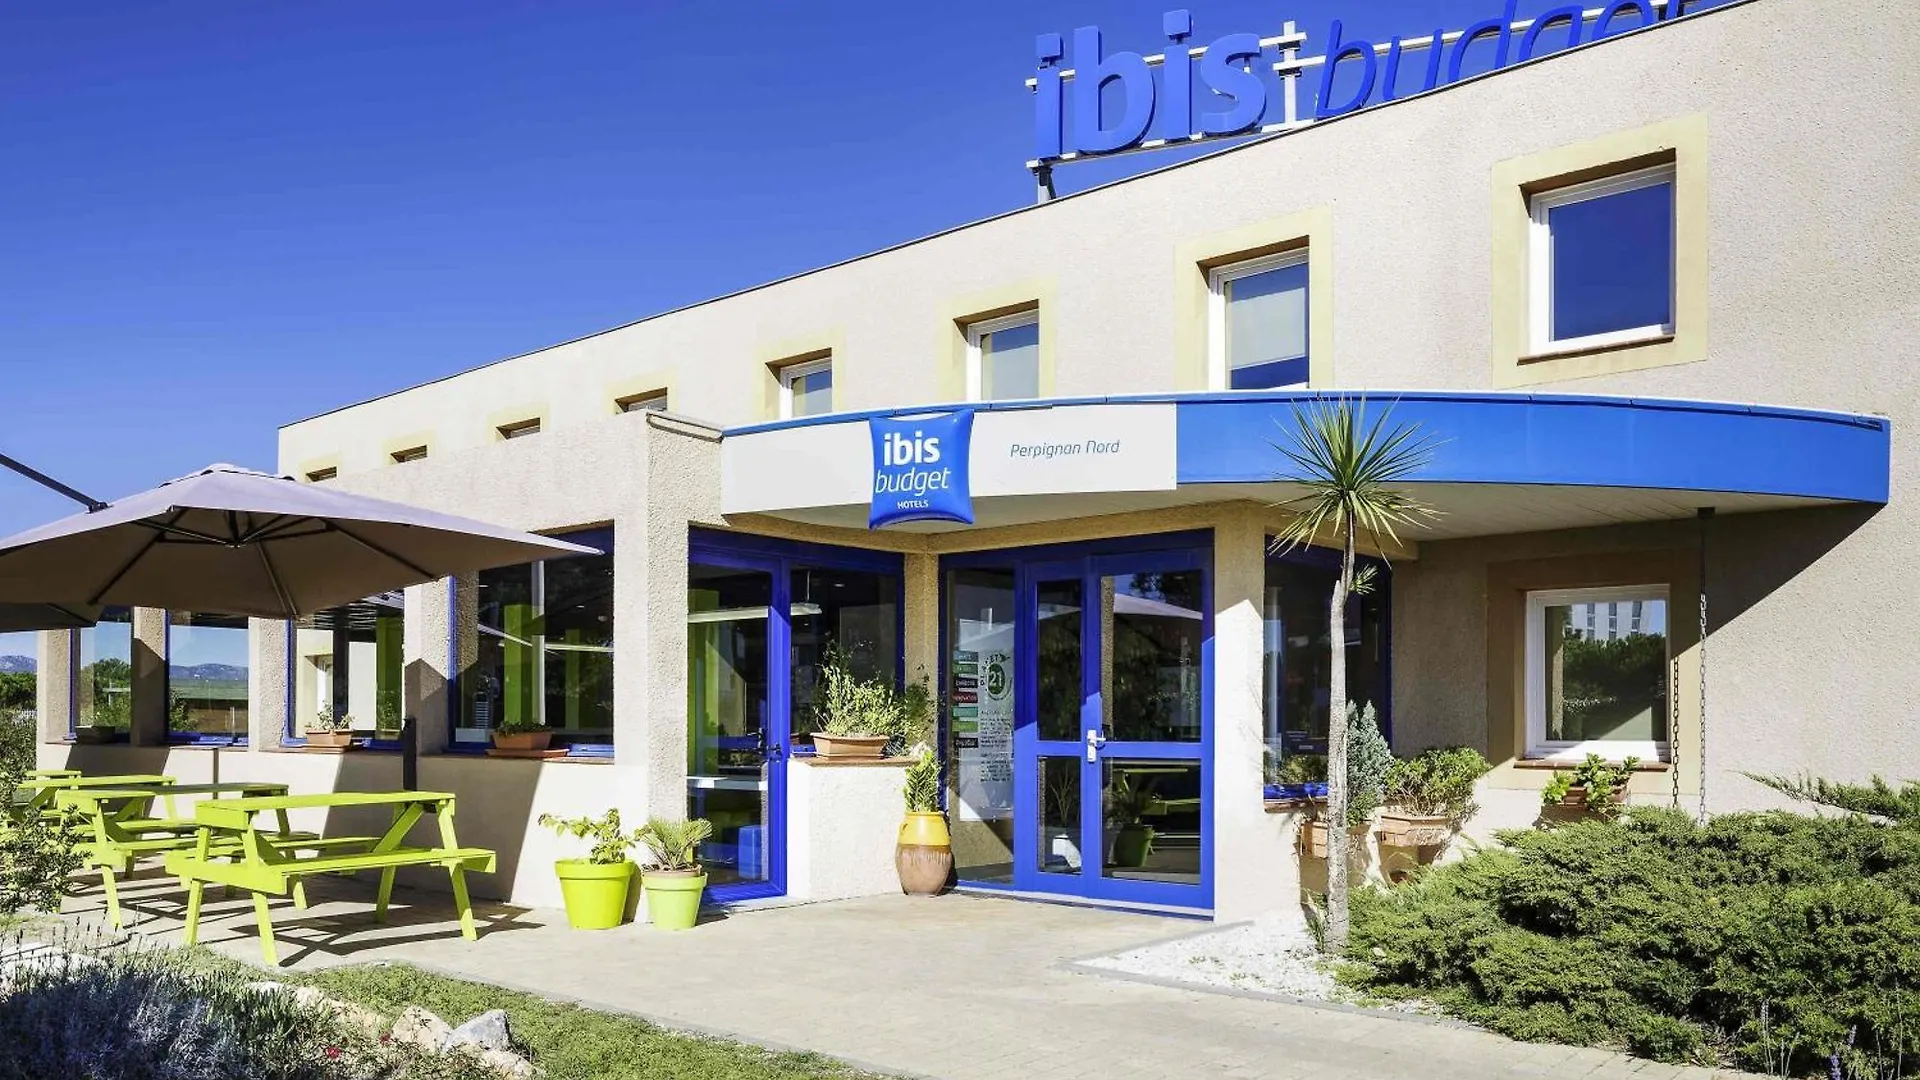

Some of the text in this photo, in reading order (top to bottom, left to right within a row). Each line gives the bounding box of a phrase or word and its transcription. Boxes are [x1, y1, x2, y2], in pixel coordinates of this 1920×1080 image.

[1036, 8, 1266, 157] ibis
[884, 431, 940, 466] ibis
[1010, 440, 1120, 460] Perpignan Nord
[875, 467, 951, 497] budget
[897, 499, 929, 509] HOTELS
[989, 670, 1002, 687] 21
